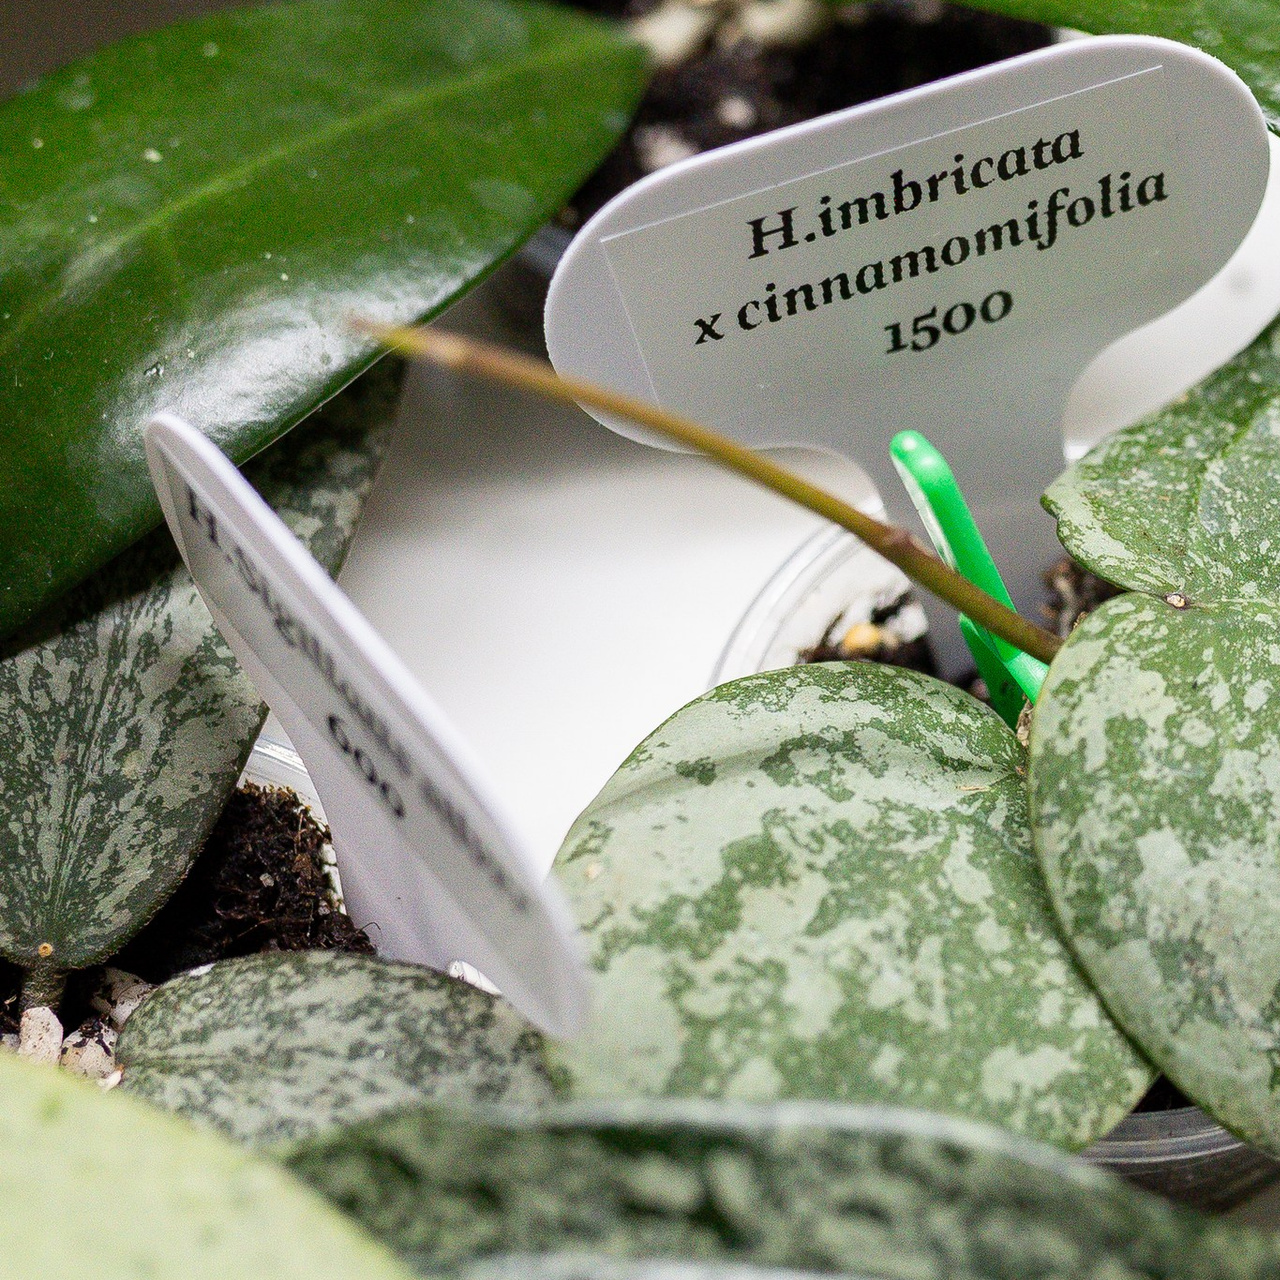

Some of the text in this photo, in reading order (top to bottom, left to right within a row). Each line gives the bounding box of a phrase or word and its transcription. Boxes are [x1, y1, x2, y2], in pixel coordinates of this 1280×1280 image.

[693, 170, 1170, 346] x cinnamomifolia
[747, 127, 1085, 260] H.imbricata
[884, 289, 1014, 356] 1500
